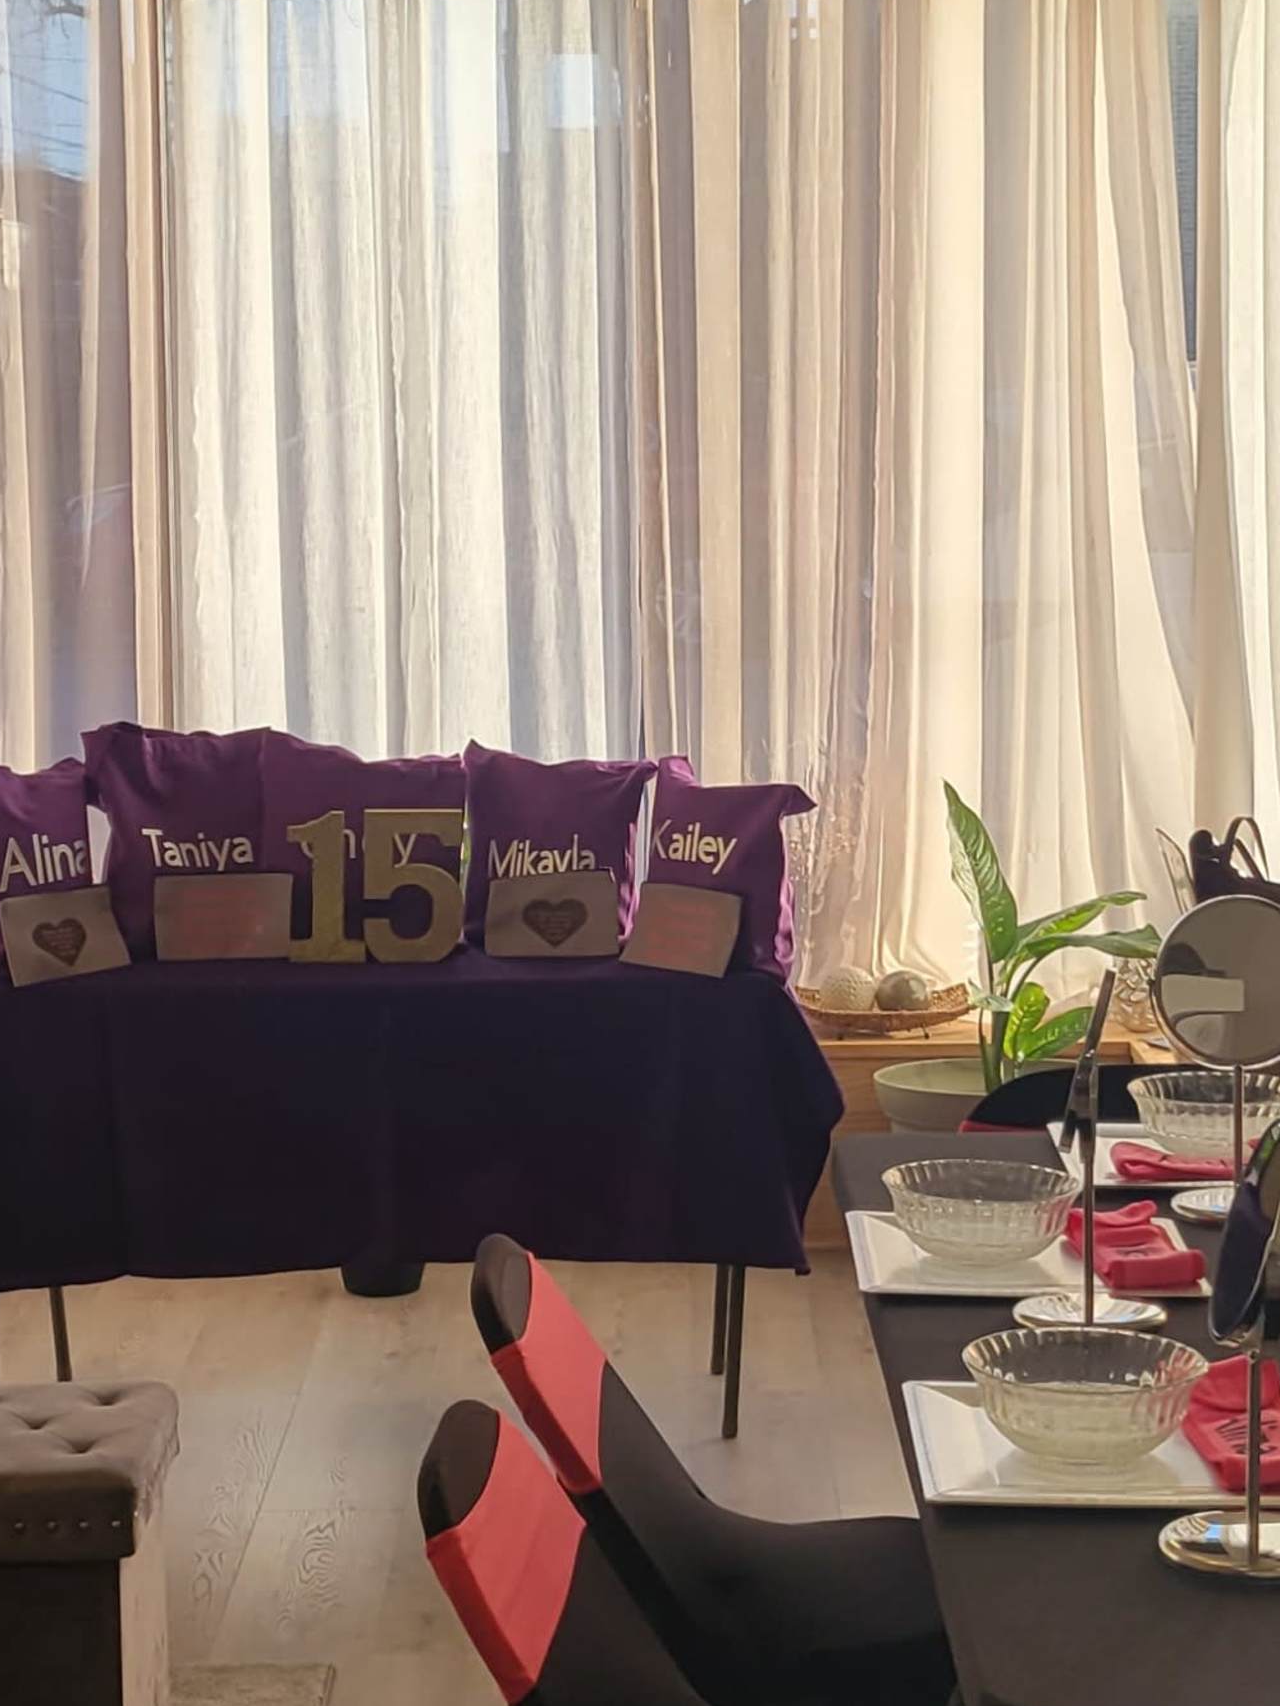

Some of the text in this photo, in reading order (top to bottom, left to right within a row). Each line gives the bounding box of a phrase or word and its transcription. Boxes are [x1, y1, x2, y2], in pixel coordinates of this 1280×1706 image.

[0, 833, 87, 892] Alina
[141, 828, 255, 871] Taniya
[652, 819, 737, 875] Kailey
[286, 808, 464, 963] 15
